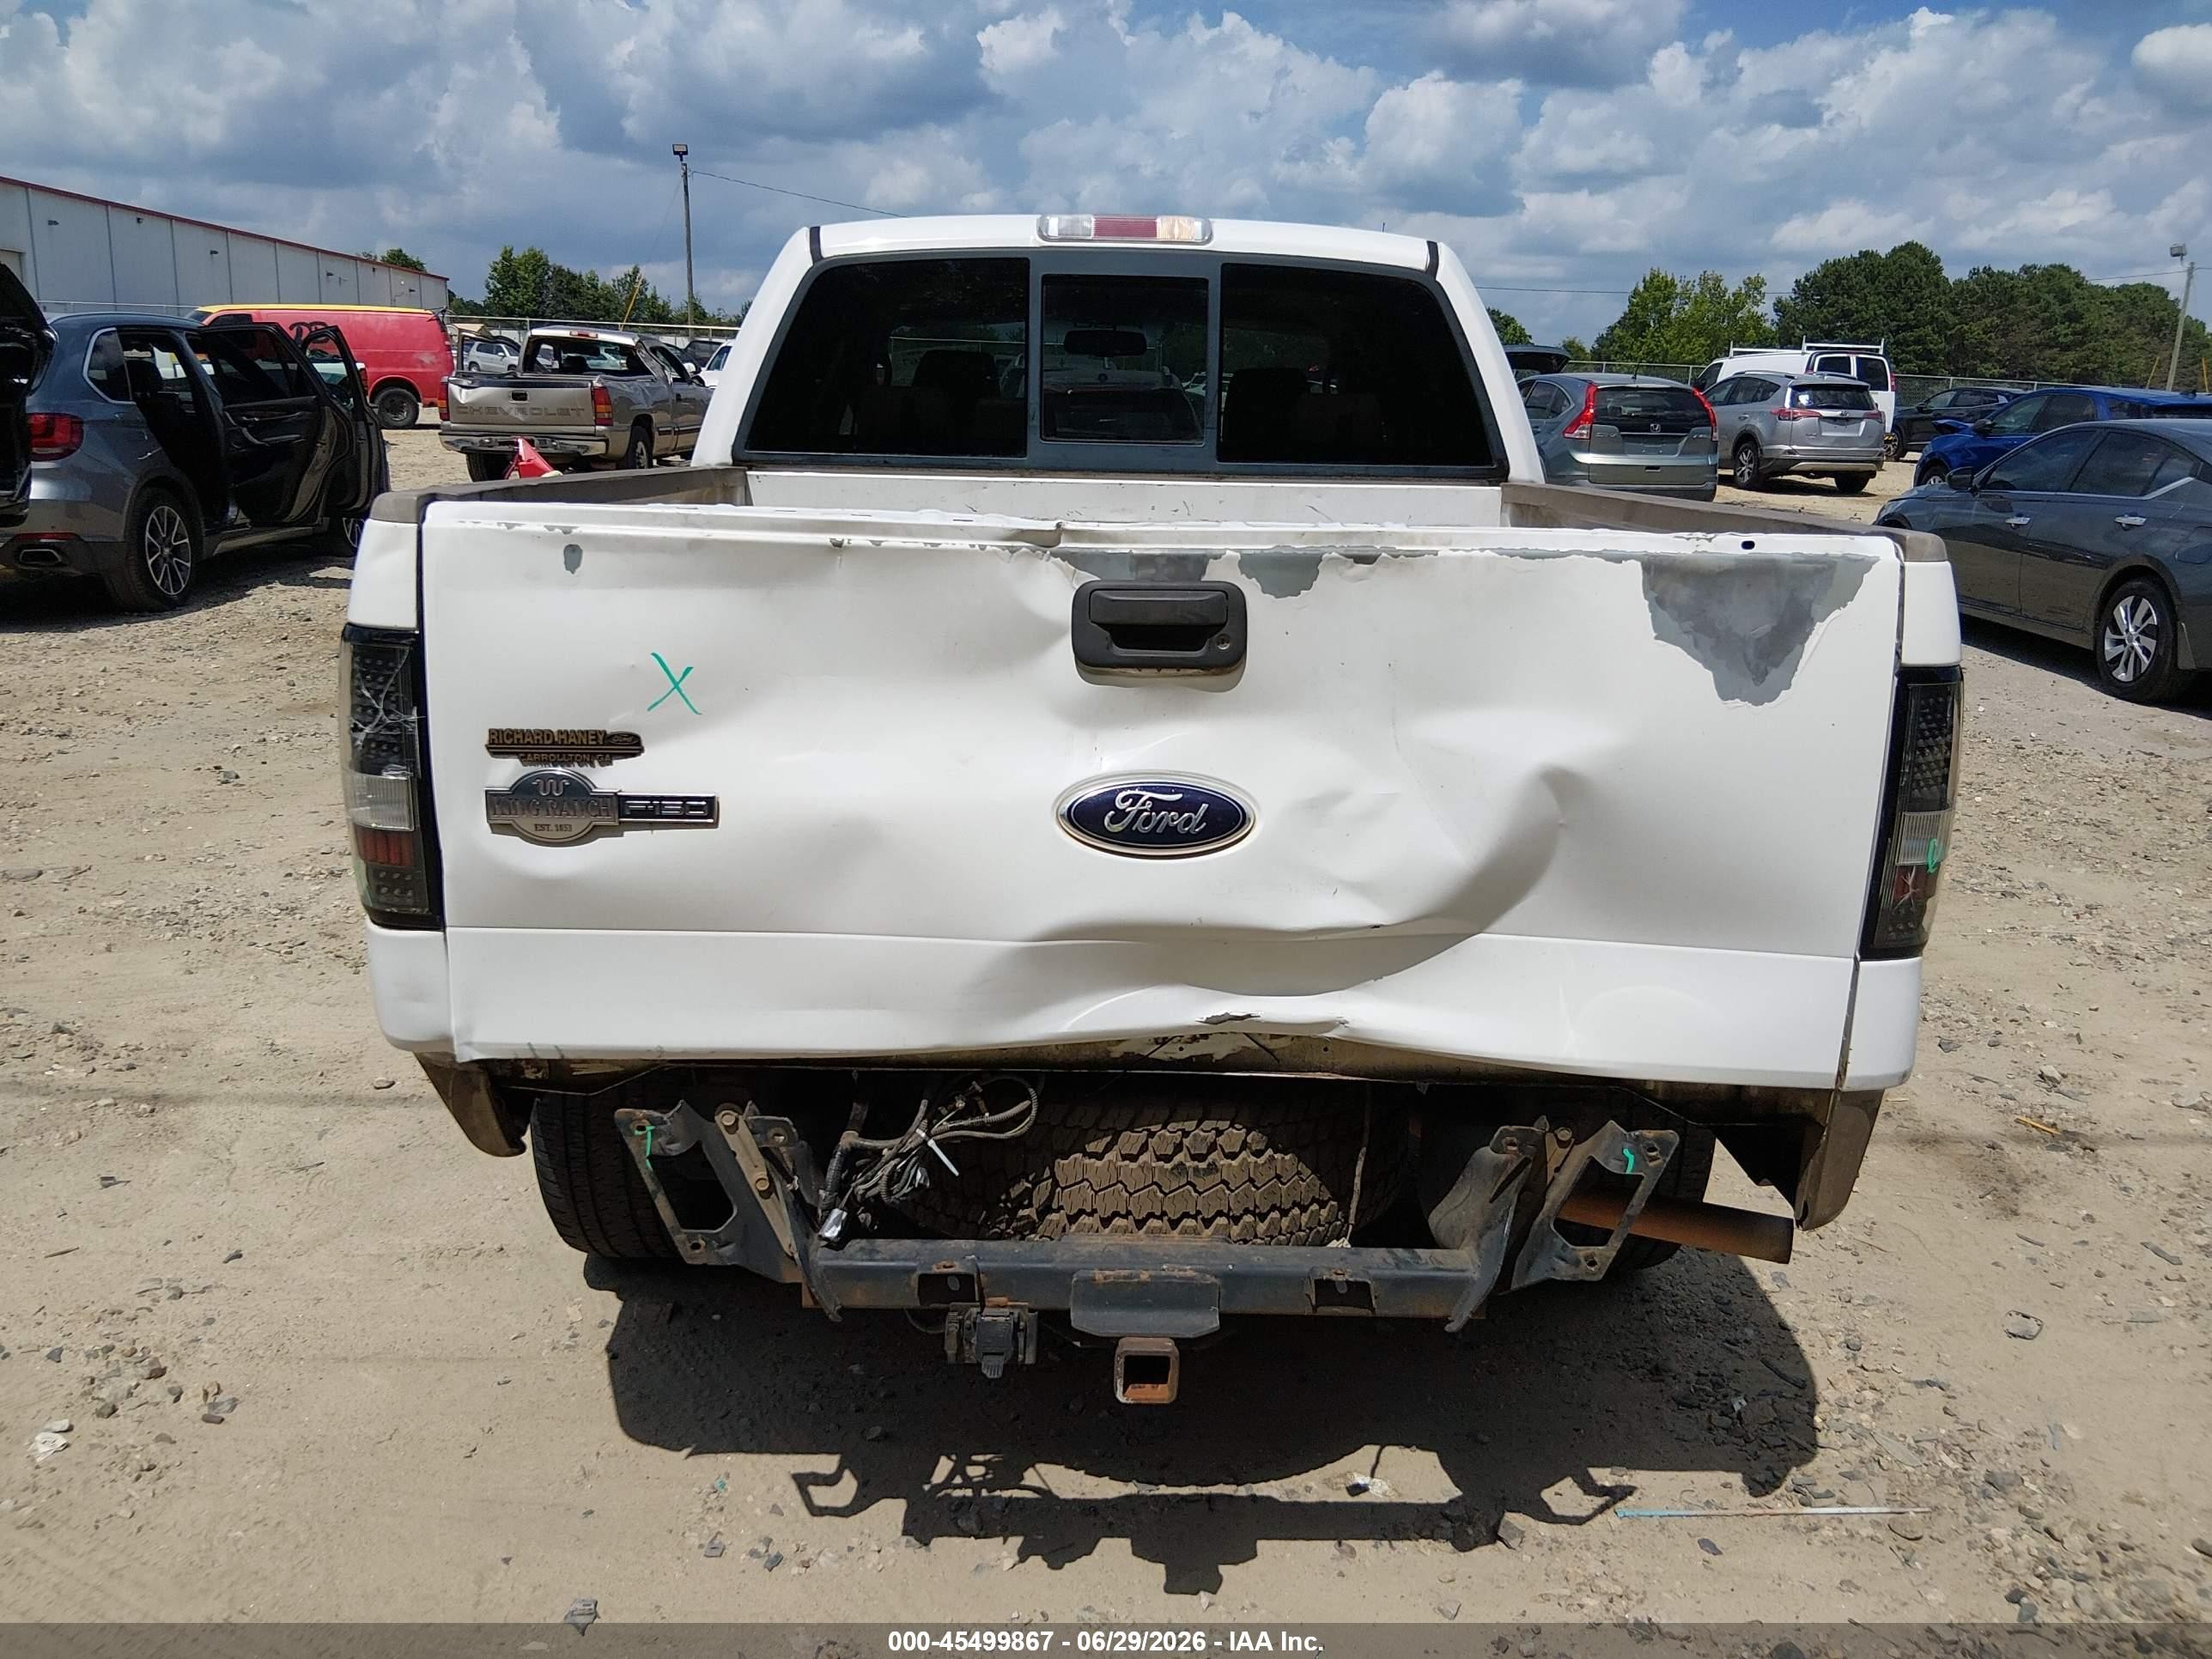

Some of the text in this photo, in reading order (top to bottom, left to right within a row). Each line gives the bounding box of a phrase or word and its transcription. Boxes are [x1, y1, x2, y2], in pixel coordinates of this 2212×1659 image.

[455, 405, 585, 416] CHEVROLET
[647, 652, 702, 715] X
[489, 729, 607, 744] RICHARD HANEY
[597, 754, 612, 763] GA
[492, 796, 615, 817] KING RANCH
[1103, 788, 1210, 835] Ford
[534, 823, 554, 832] EST.
